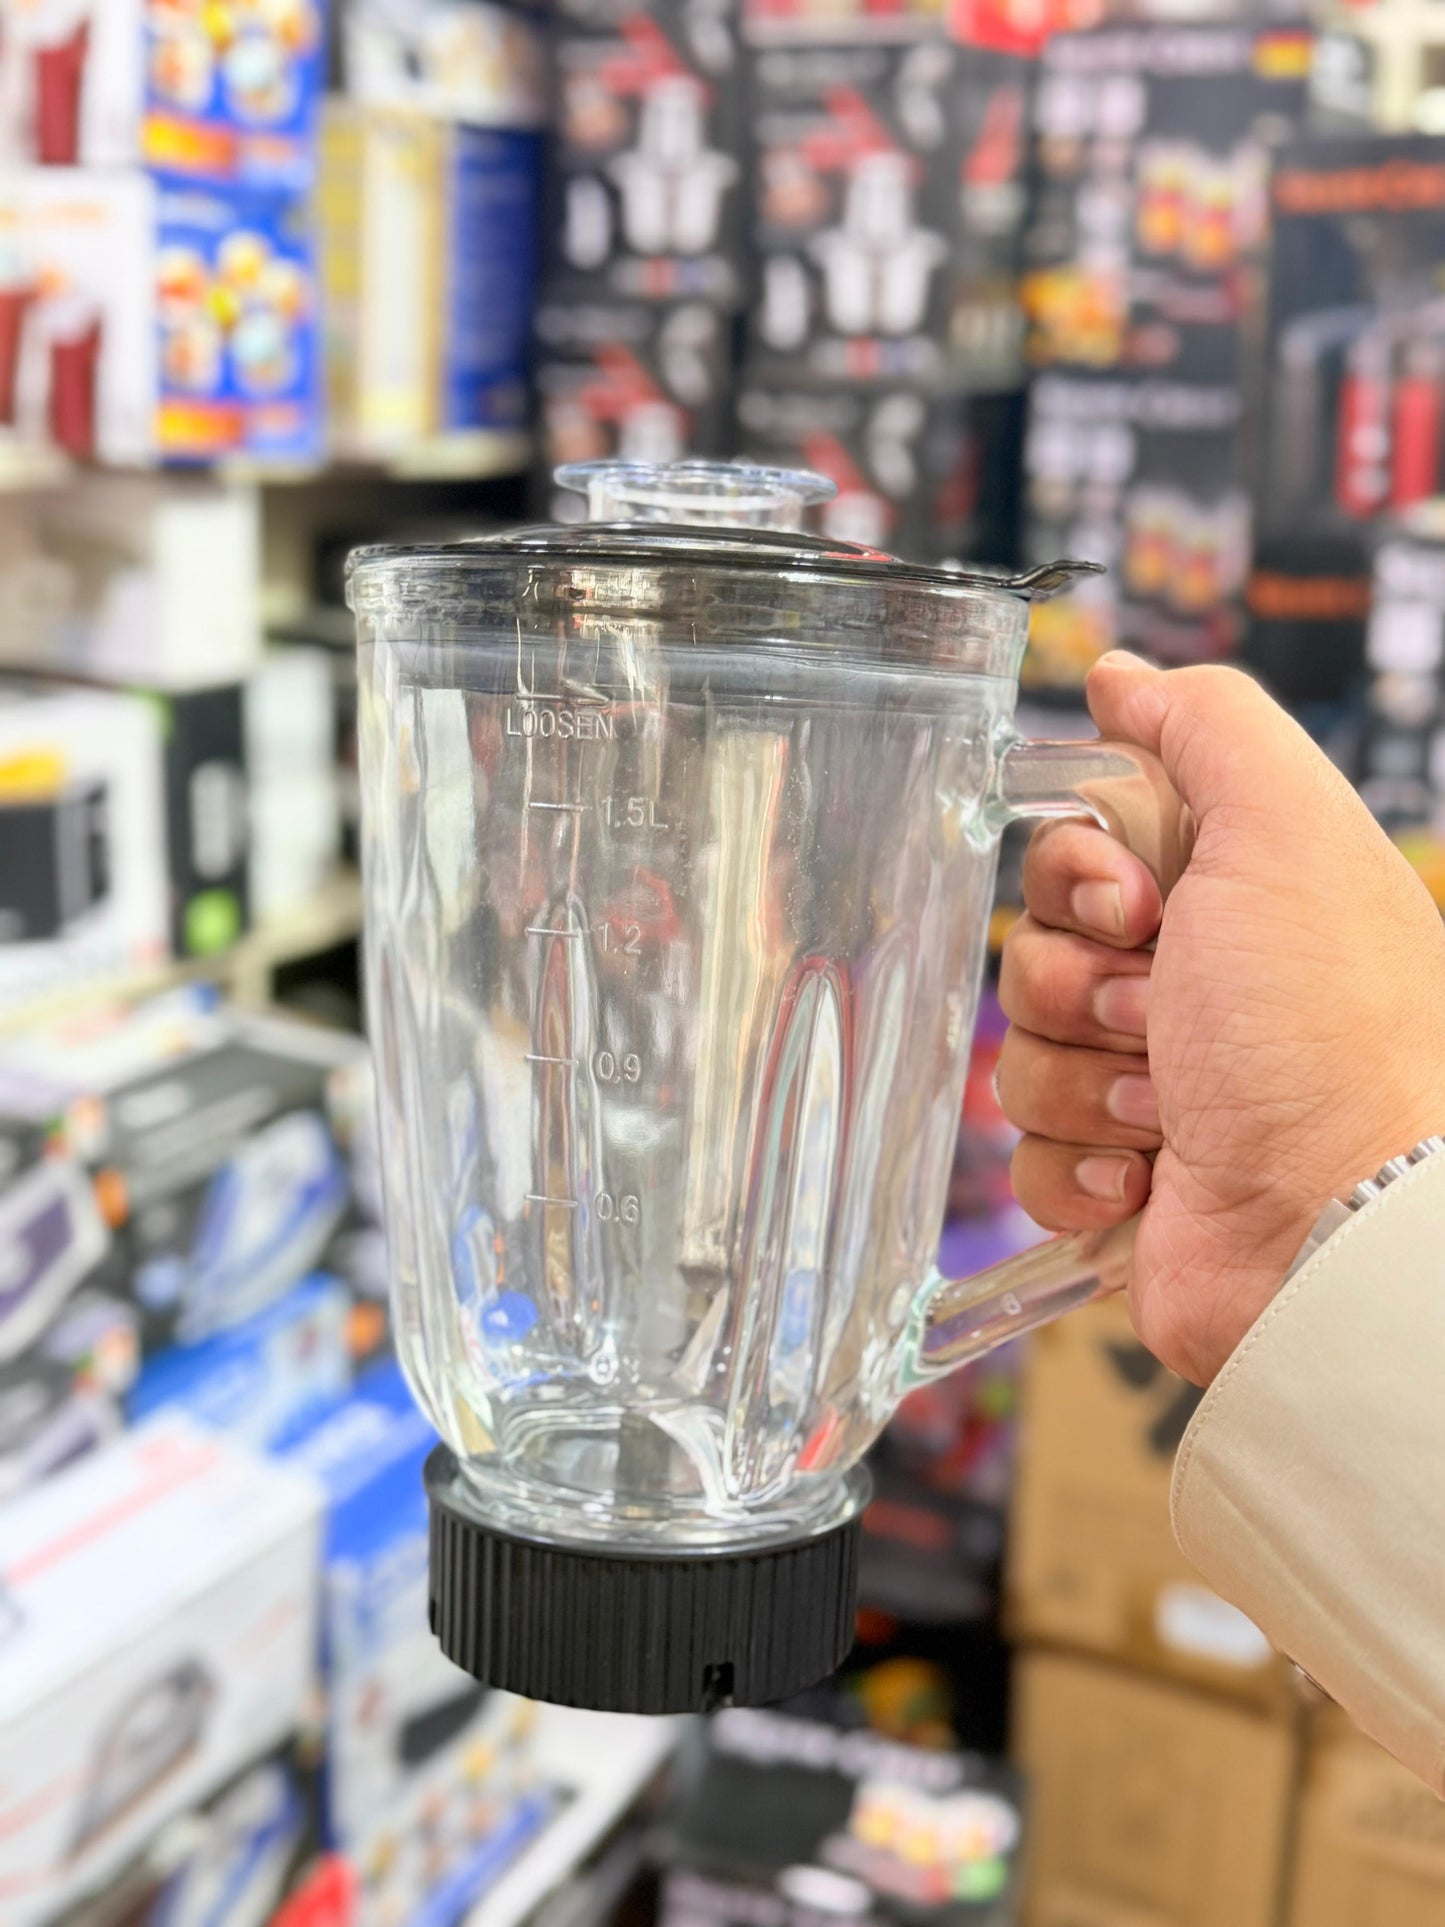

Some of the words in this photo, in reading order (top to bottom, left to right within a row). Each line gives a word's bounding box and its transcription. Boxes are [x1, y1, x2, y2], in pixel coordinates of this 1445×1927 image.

[506, 707, 617, 740] LOOSEN
[602, 795, 668, 829] 1.5L
[598, 922, 641, 955] 1.2
[599, 1051, 641, 1084] 0.9
[593, 1191, 639, 1224] 0.6
